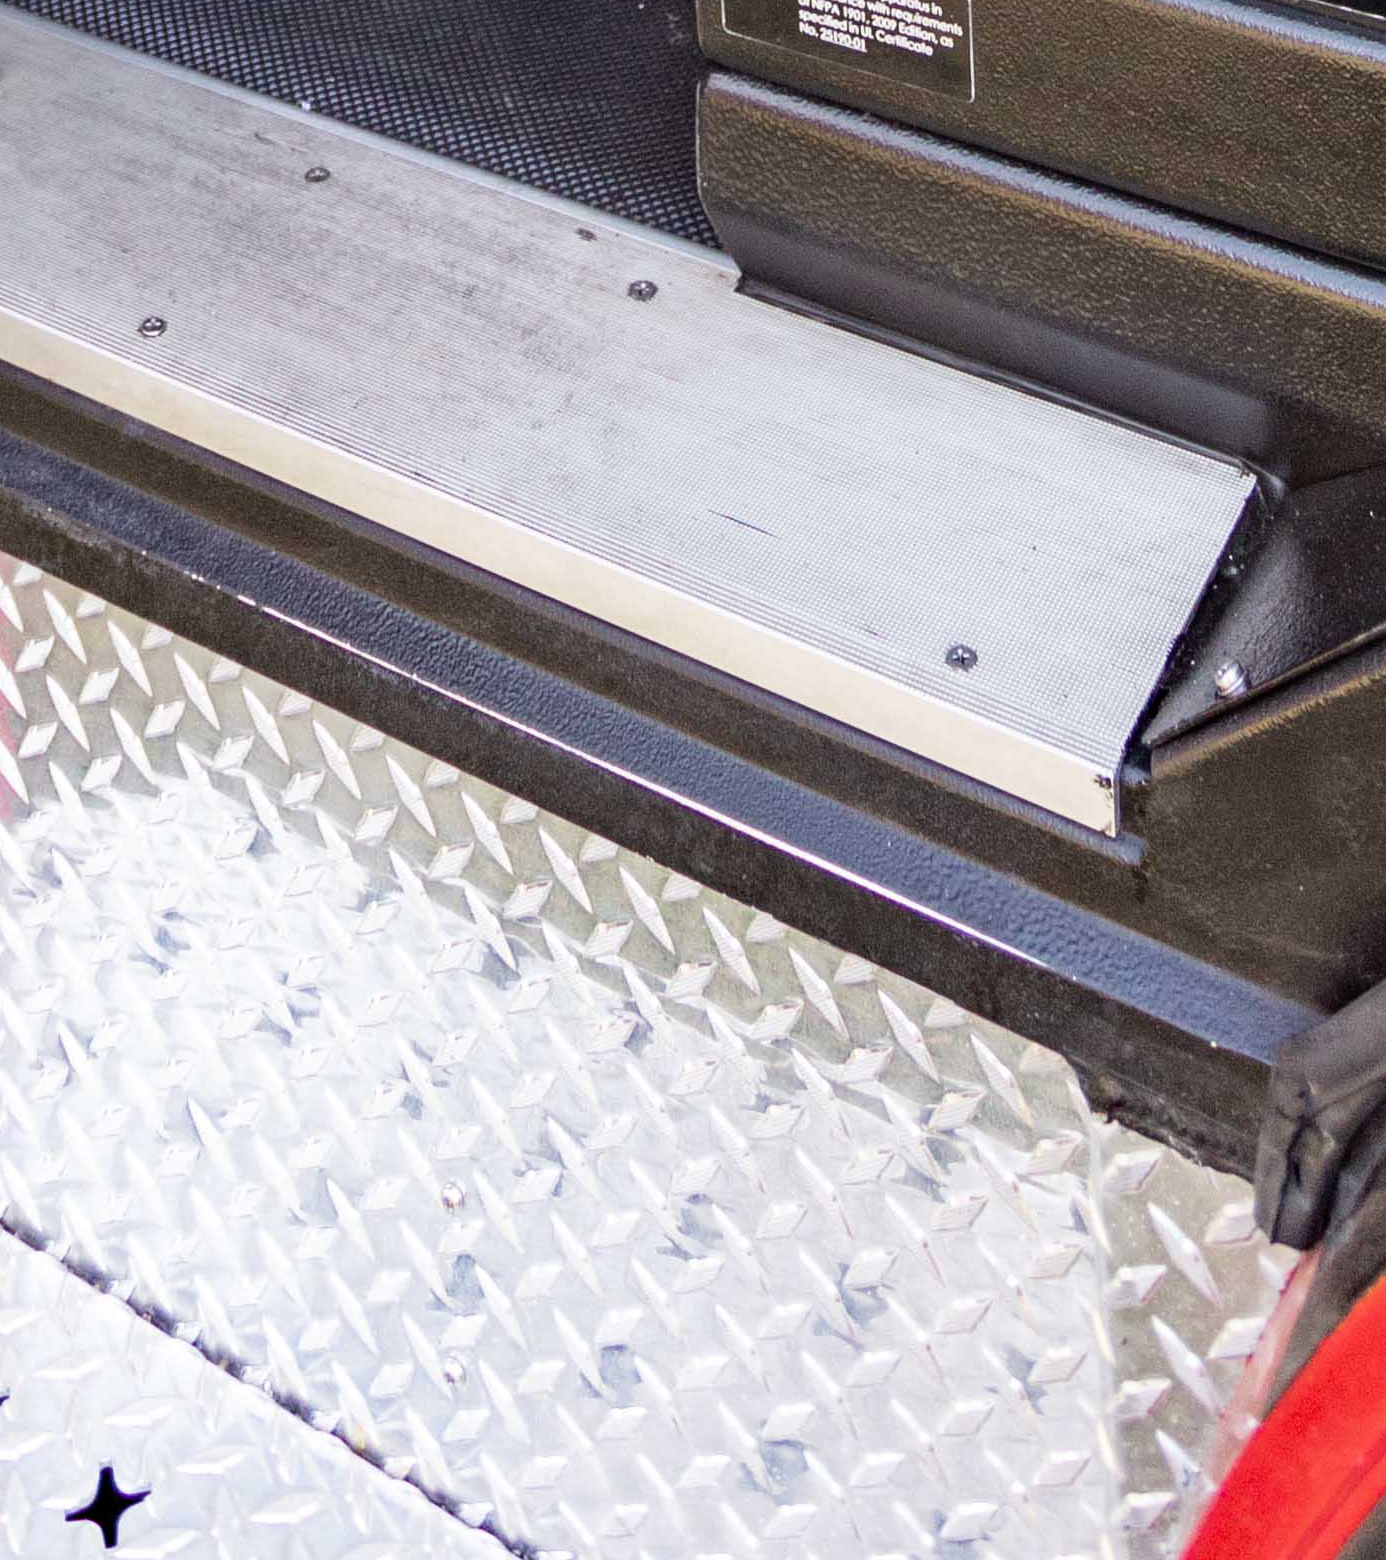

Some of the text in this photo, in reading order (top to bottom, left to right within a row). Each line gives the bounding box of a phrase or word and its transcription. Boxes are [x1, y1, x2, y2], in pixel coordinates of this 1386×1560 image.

[812, 0, 839, 15] NFPA
[843, 6, 869, 24] 1901,
[872, 14, 897, 30] 2009
[899, 21, 938, 43] Edition,
[940, 37, 953, 48] as
[867, 1, 890, 16] with
[892, 7, 963, 36] requirements
[932, 2, 942, 16] in
[799, 22, 818, 37] No.
[799, 10, 933, 56] specified in UL Certificate
